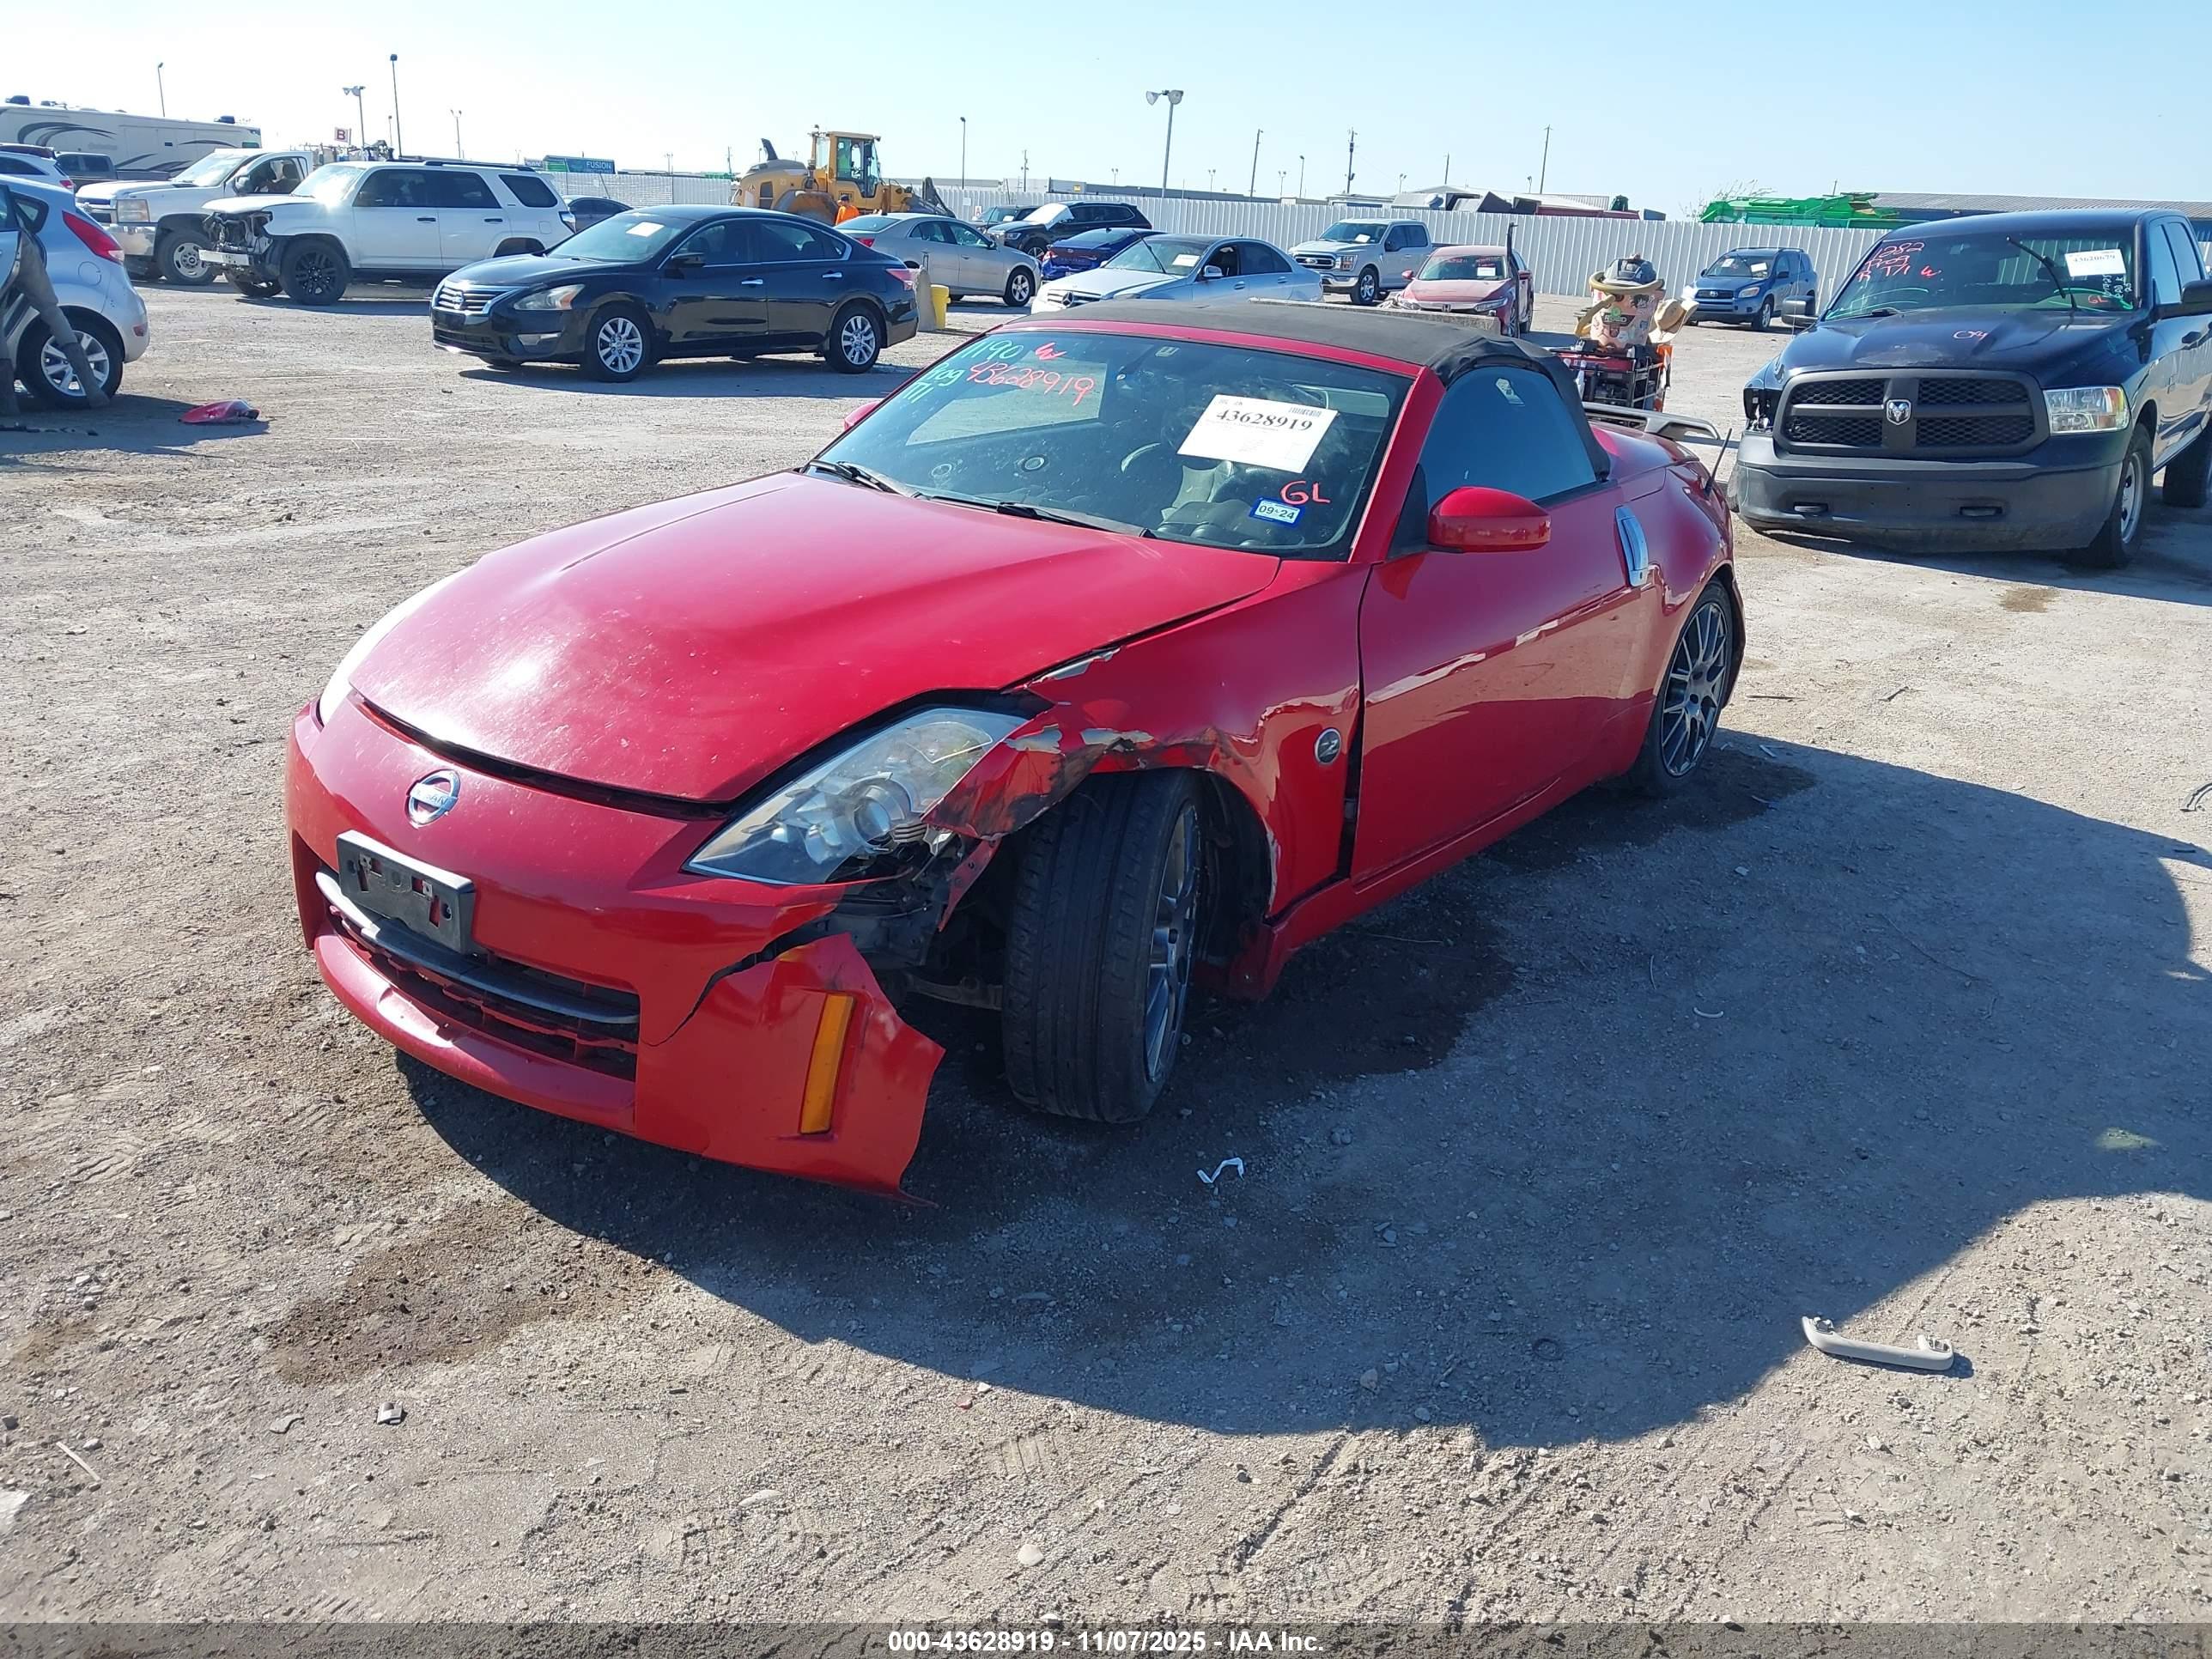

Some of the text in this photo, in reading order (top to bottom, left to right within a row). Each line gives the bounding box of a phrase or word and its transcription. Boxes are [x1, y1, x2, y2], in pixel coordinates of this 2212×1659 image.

[337, 129, 346, 140] B
[586, 161, 611, 170] FUSION
[961, 340, 1024, 360] 1190
[966, 359, 1096, 406] 43628919
[1216, 409, 1313, 431] 43628919
[1280, 480, 1331, 505] GL
